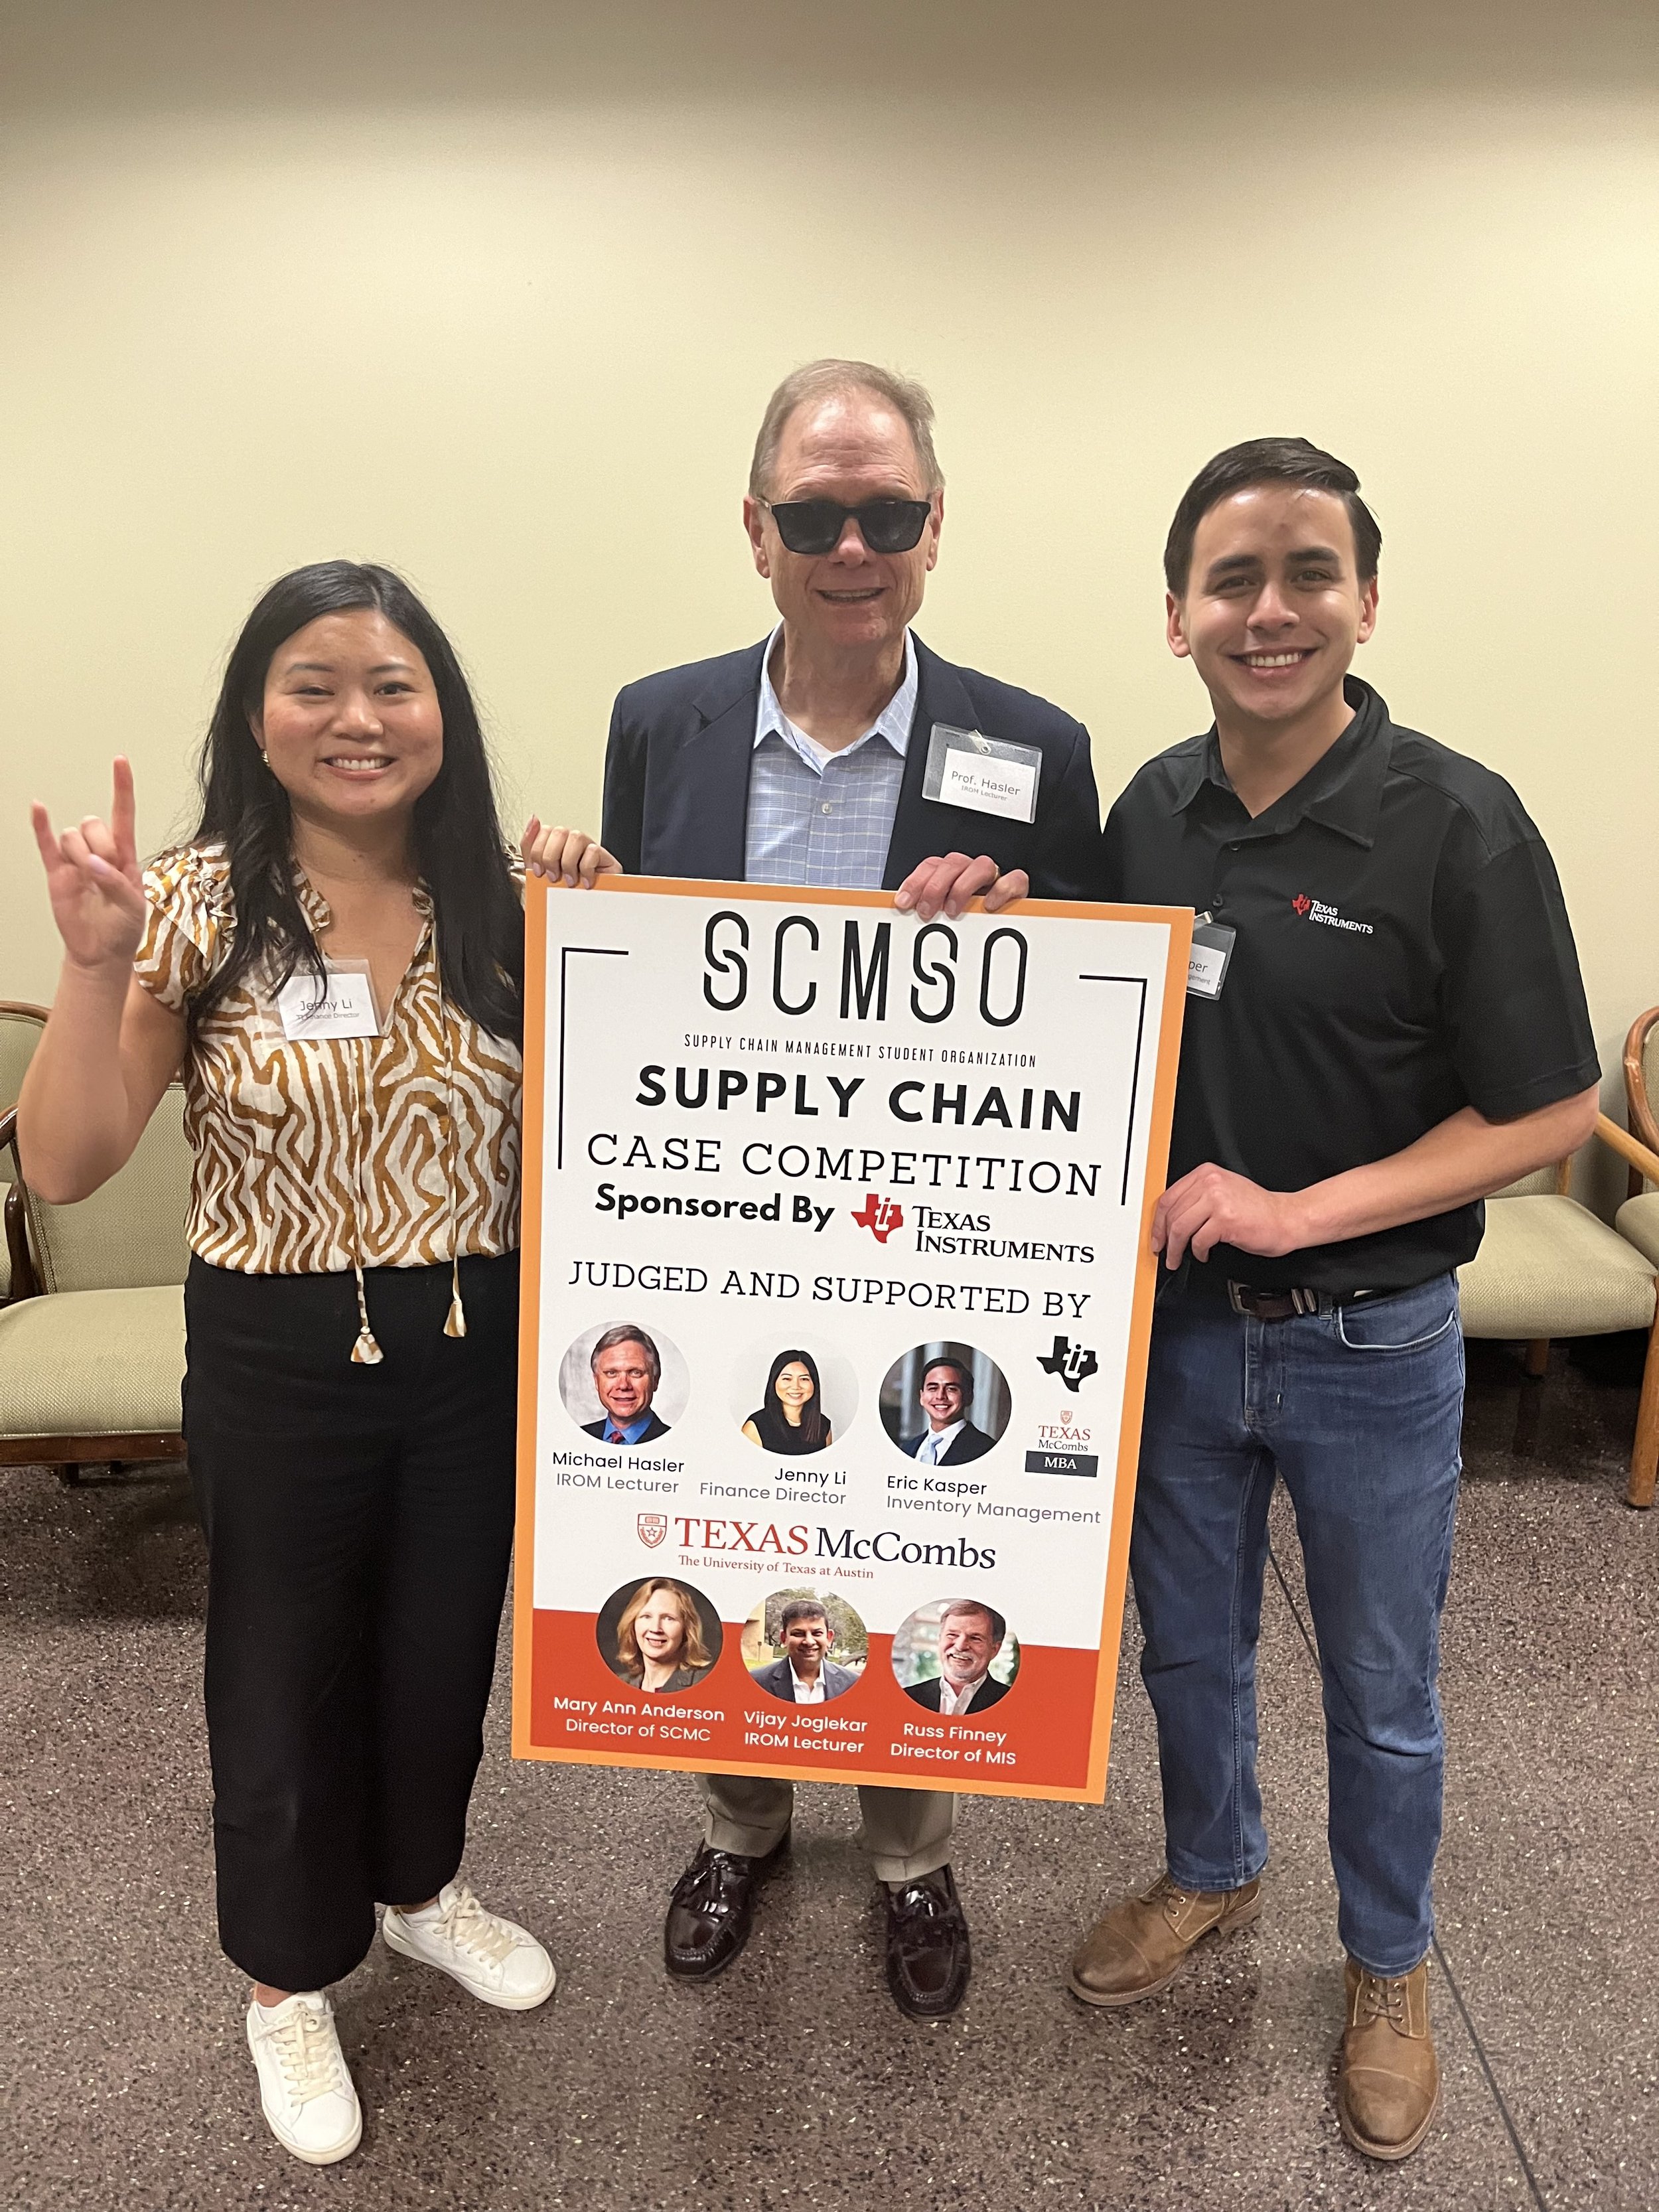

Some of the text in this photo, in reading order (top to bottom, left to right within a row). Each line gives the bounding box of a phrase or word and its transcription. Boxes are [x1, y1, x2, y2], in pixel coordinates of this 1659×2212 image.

[952, 771, 1021, 795] Prof. Hasler
[704, 911, 1027, 1027] SCMSO
[301, 998, 353, 1011] Jenny Li
[685, 1034, 1035, 1067] SUPPLY CHAIN MANAGEMENT STUDENT ORGANIZATION
[636, 1065, 1080, 1132] SUPPLY CHAIN
[588, 1134, 1102, 1196] CASE COMPETITION
[595, 1183, 835, 1232] Sponsored By
[568, 1262, 1090, 1318] JUDGED AND SUPPORTED BY
[1038, 1425, 1091, 1440] TEXAS
[1039, 1438, 1088, 1451] McCombs
[553, 1452, 684, 1472] Michael Hasler
[1045, 1457, 1076, 1469] MBA
[557, 1473, 678, 1493] IROM Lecturer
[775, 1468, 845, 1487] Jenny Li
[888, 1476, 987, 1497] Eric Kasper
[701, 1483, 845, 1504] Finance Director
[888, 1496, 1100, 1523] Inventory Management
[675, 1518, 995, 1569] TEXAS McCombs
[678, 1554, 699, 1566] The
[704, 1557, 764, 1573] University
[767, 1562, 779, 1571] of
[784, 1562, 816, 1575] Texas
[834, 1567, 873, 1578] Austin
[554, 1697, 724, 1721] Mary Ann Anderson
[567, 1719, 710, 1741] Director of SCMC
[744, 1711, 867, 1732] Vijay Joglekar
[745, 1732, 864, 1752] IROM Lecturer
[904, 1724, 1007, 1745] Russ Finney
[891, 1743, 1015, 1764] Director of MIS
